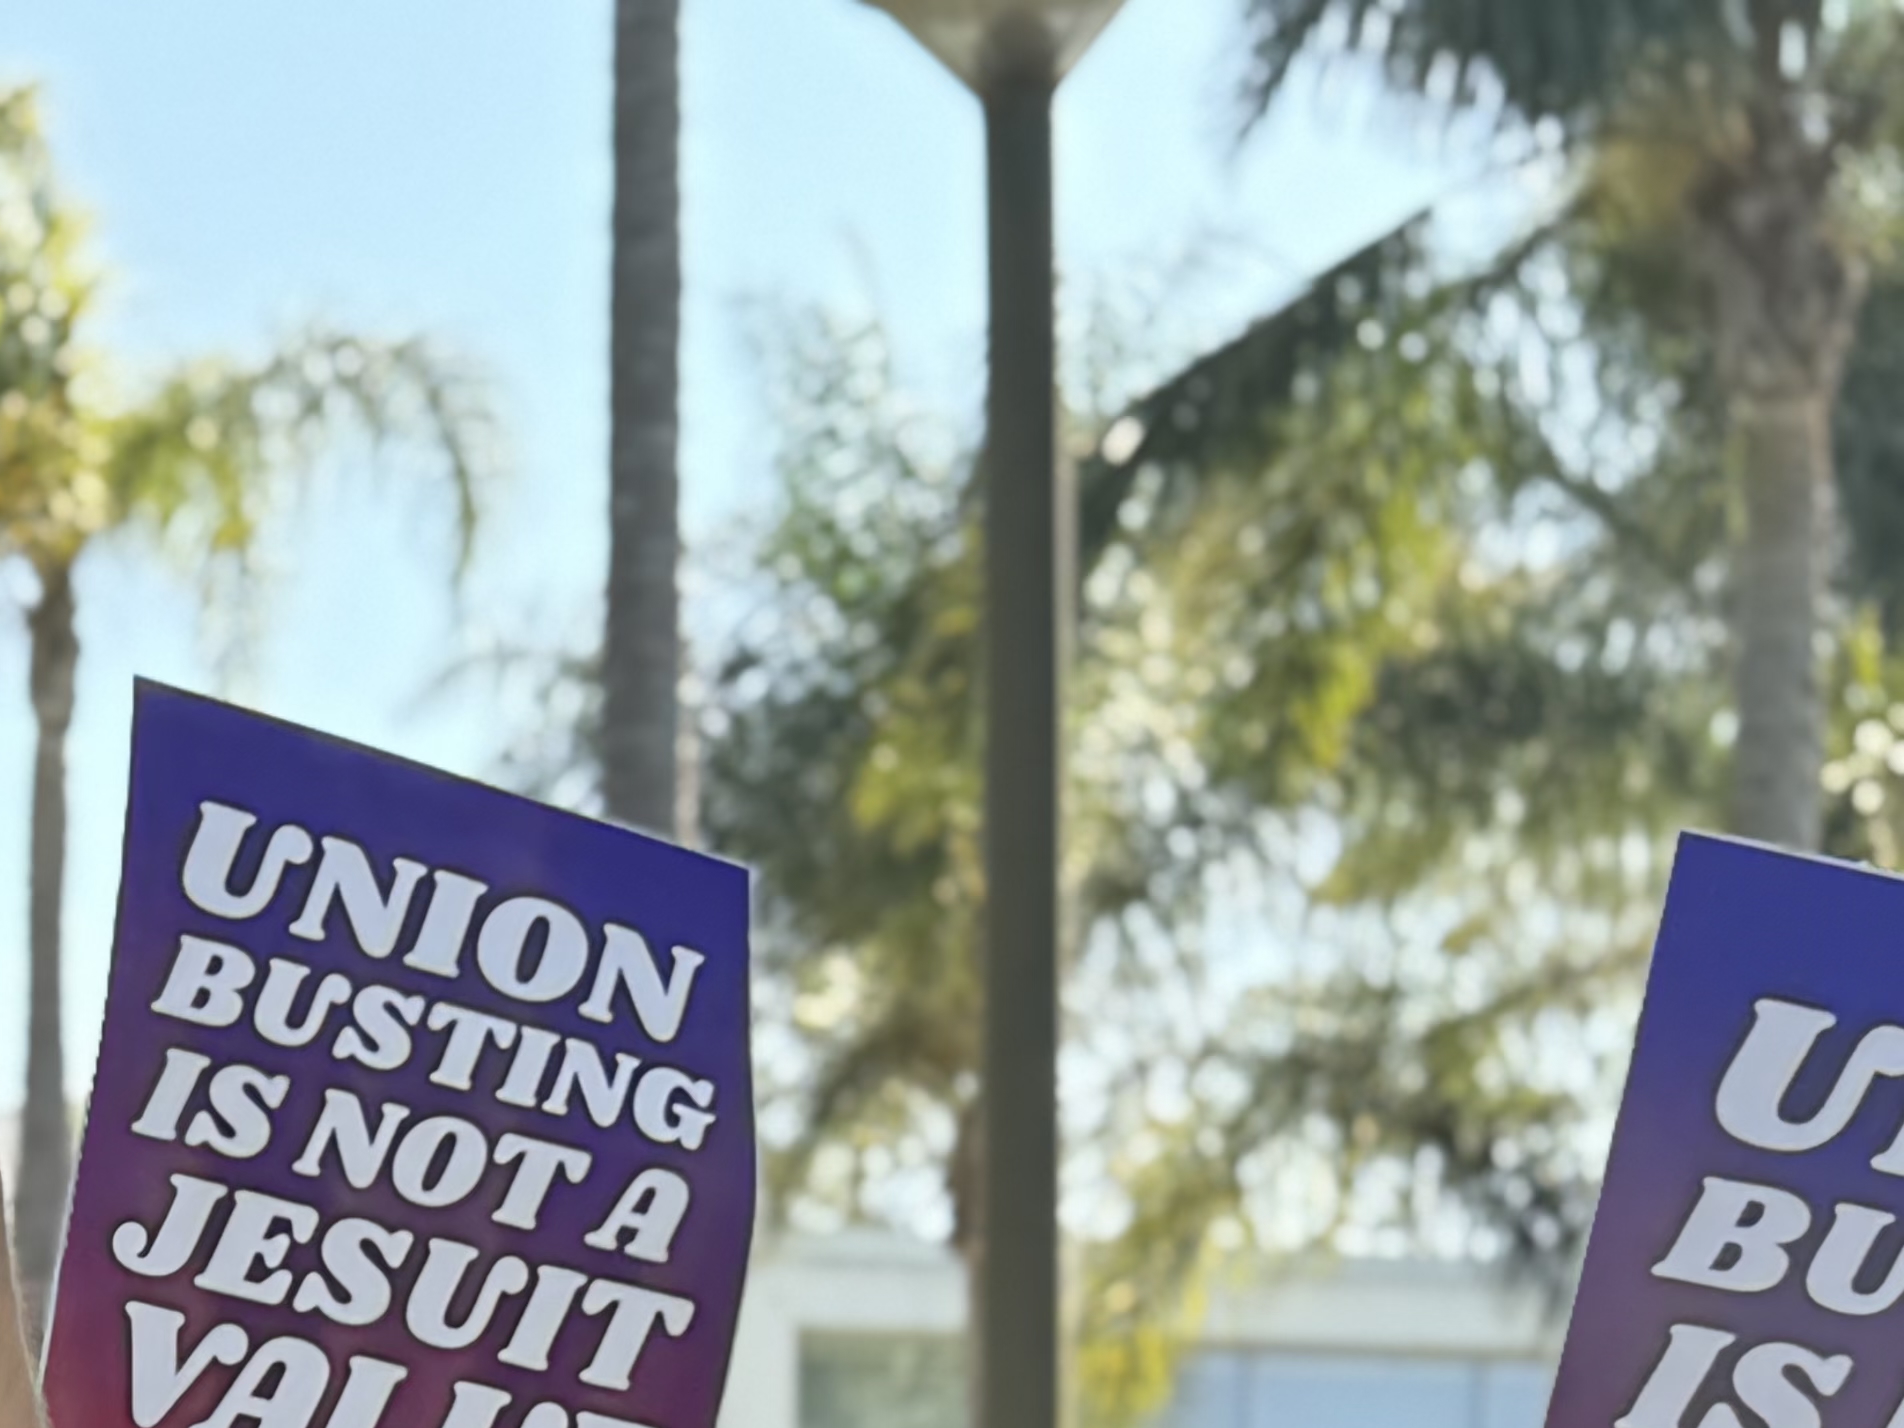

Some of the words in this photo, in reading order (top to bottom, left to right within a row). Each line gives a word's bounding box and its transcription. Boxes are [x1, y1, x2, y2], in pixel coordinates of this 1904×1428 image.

[181, 800, 704, 1042] UNION
[151, 933, 716, 1150] BUSTING
[131, 1048, 290, 1158] IS
[292, 1089, 592, 1230] NOT
[585, 1167, 690, 1262] A
[111, 1172, 695, 1390] JESUIT
